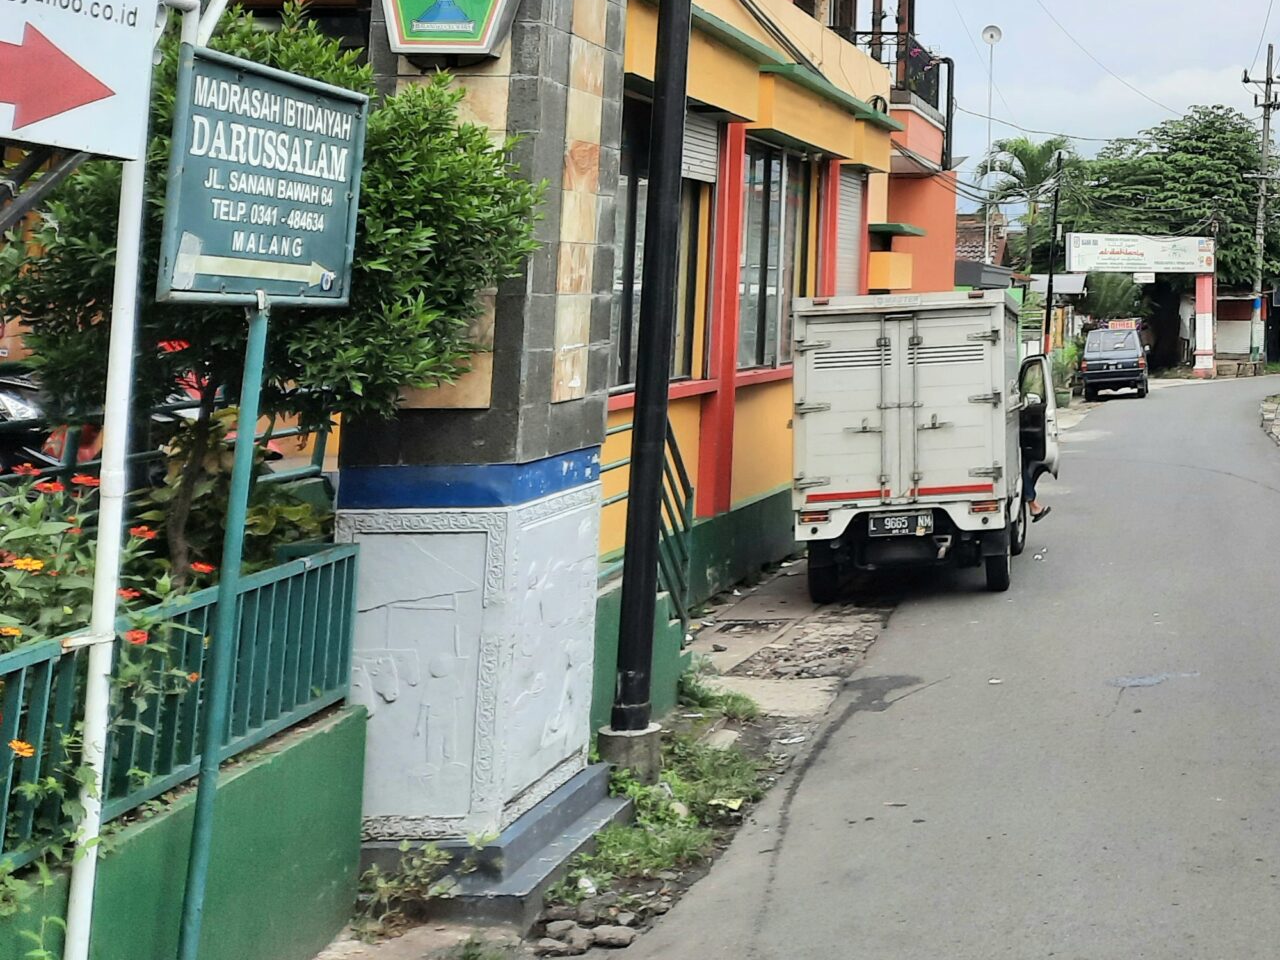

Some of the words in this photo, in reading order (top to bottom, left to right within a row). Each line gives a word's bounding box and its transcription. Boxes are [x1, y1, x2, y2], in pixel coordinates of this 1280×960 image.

[194, 76, 280, 121] MADRASAH
[283, 98, 351, 141] IBTIDAIYAH
[190, 115, 348, 182] DARUSSALAM
[204, 168, 225, 190] JL.
[228, 171, 276, 198] SANAN
[277, 179, 320, 204] BAWAH
[321, 188, 333, 206] 64
[212, 198, 247, 224] TELP.
[250, 204, 277, 226] 0341
[232, 231, 302, 257] MALANG
[870, 518, 877, 530] L
[884, 516, 909, 530] 9665
